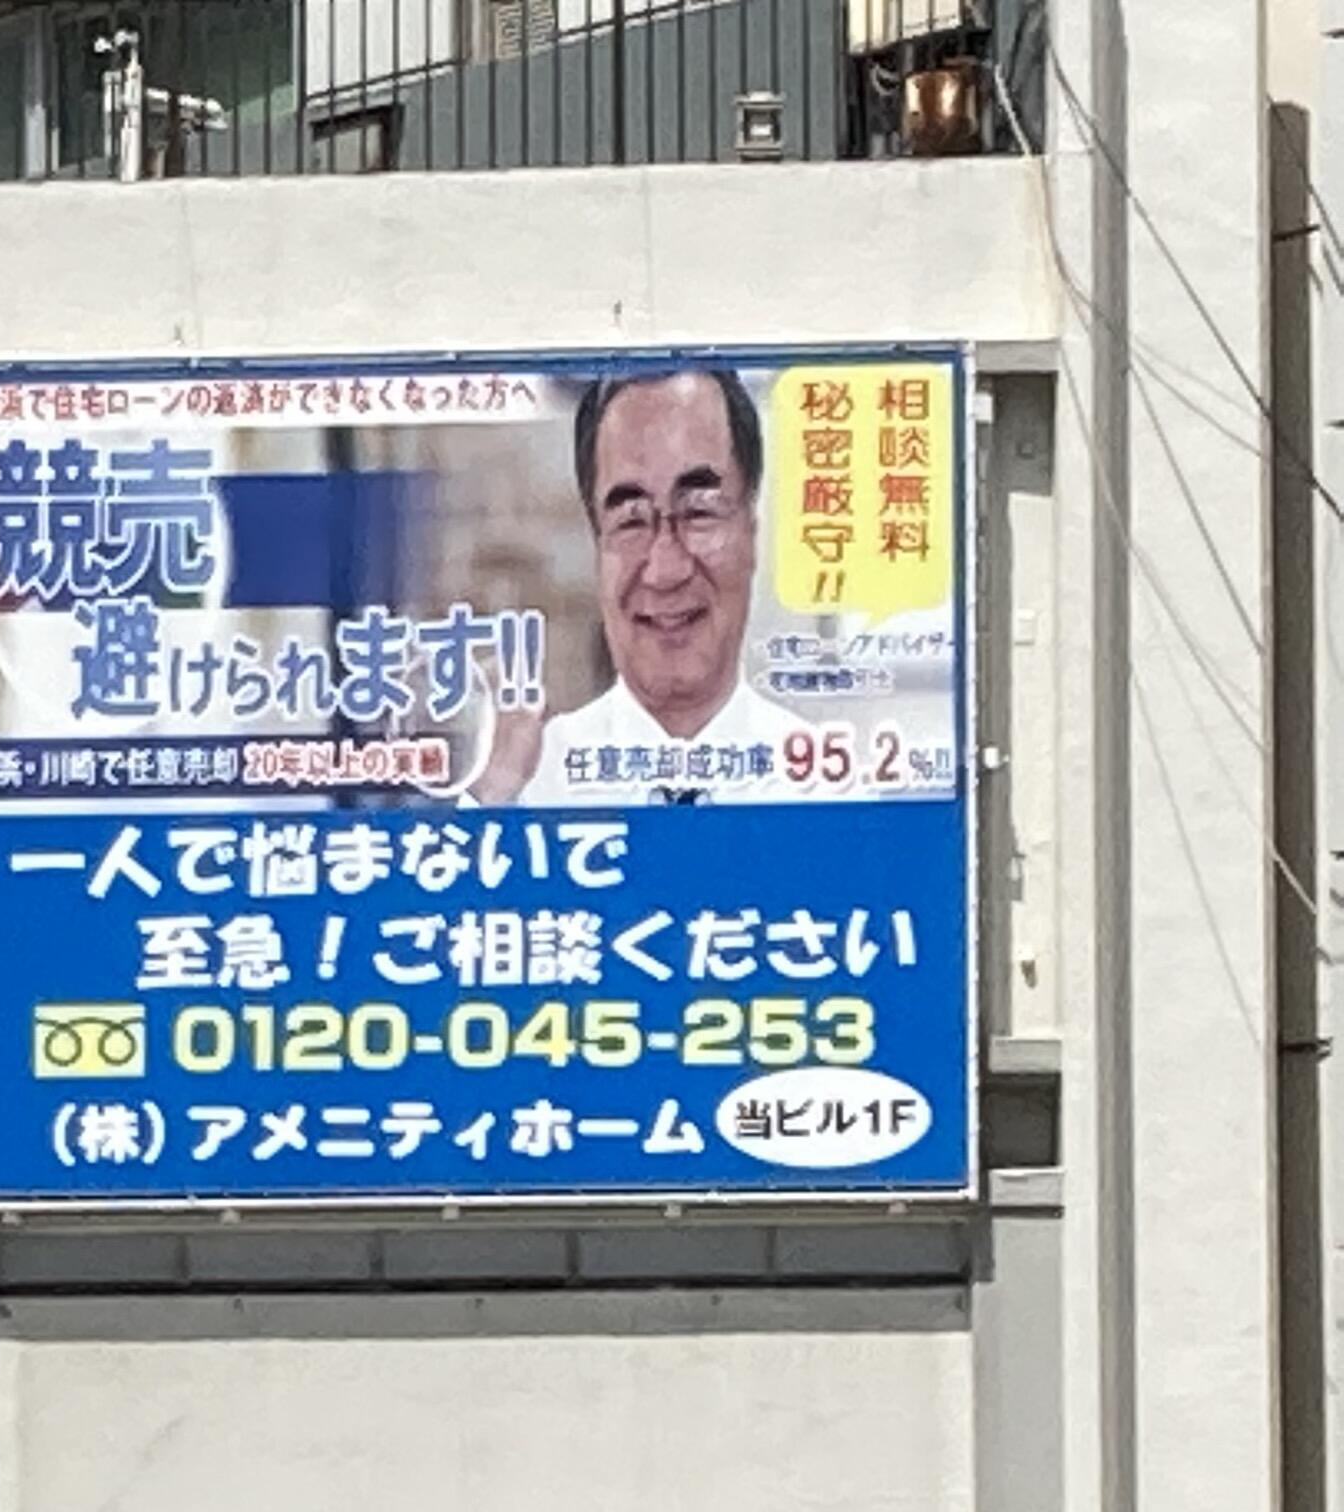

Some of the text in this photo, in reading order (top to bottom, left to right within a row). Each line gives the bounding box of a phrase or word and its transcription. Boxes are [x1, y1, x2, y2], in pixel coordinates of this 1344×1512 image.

[877, 378, 930, 563] 相談無料
[8, 820, 630, 900] 一人で悩まないで
[170, 1000, 876, 1072] 0120-045-253
[732, 1096, 918, 1142] 当ビル1F
